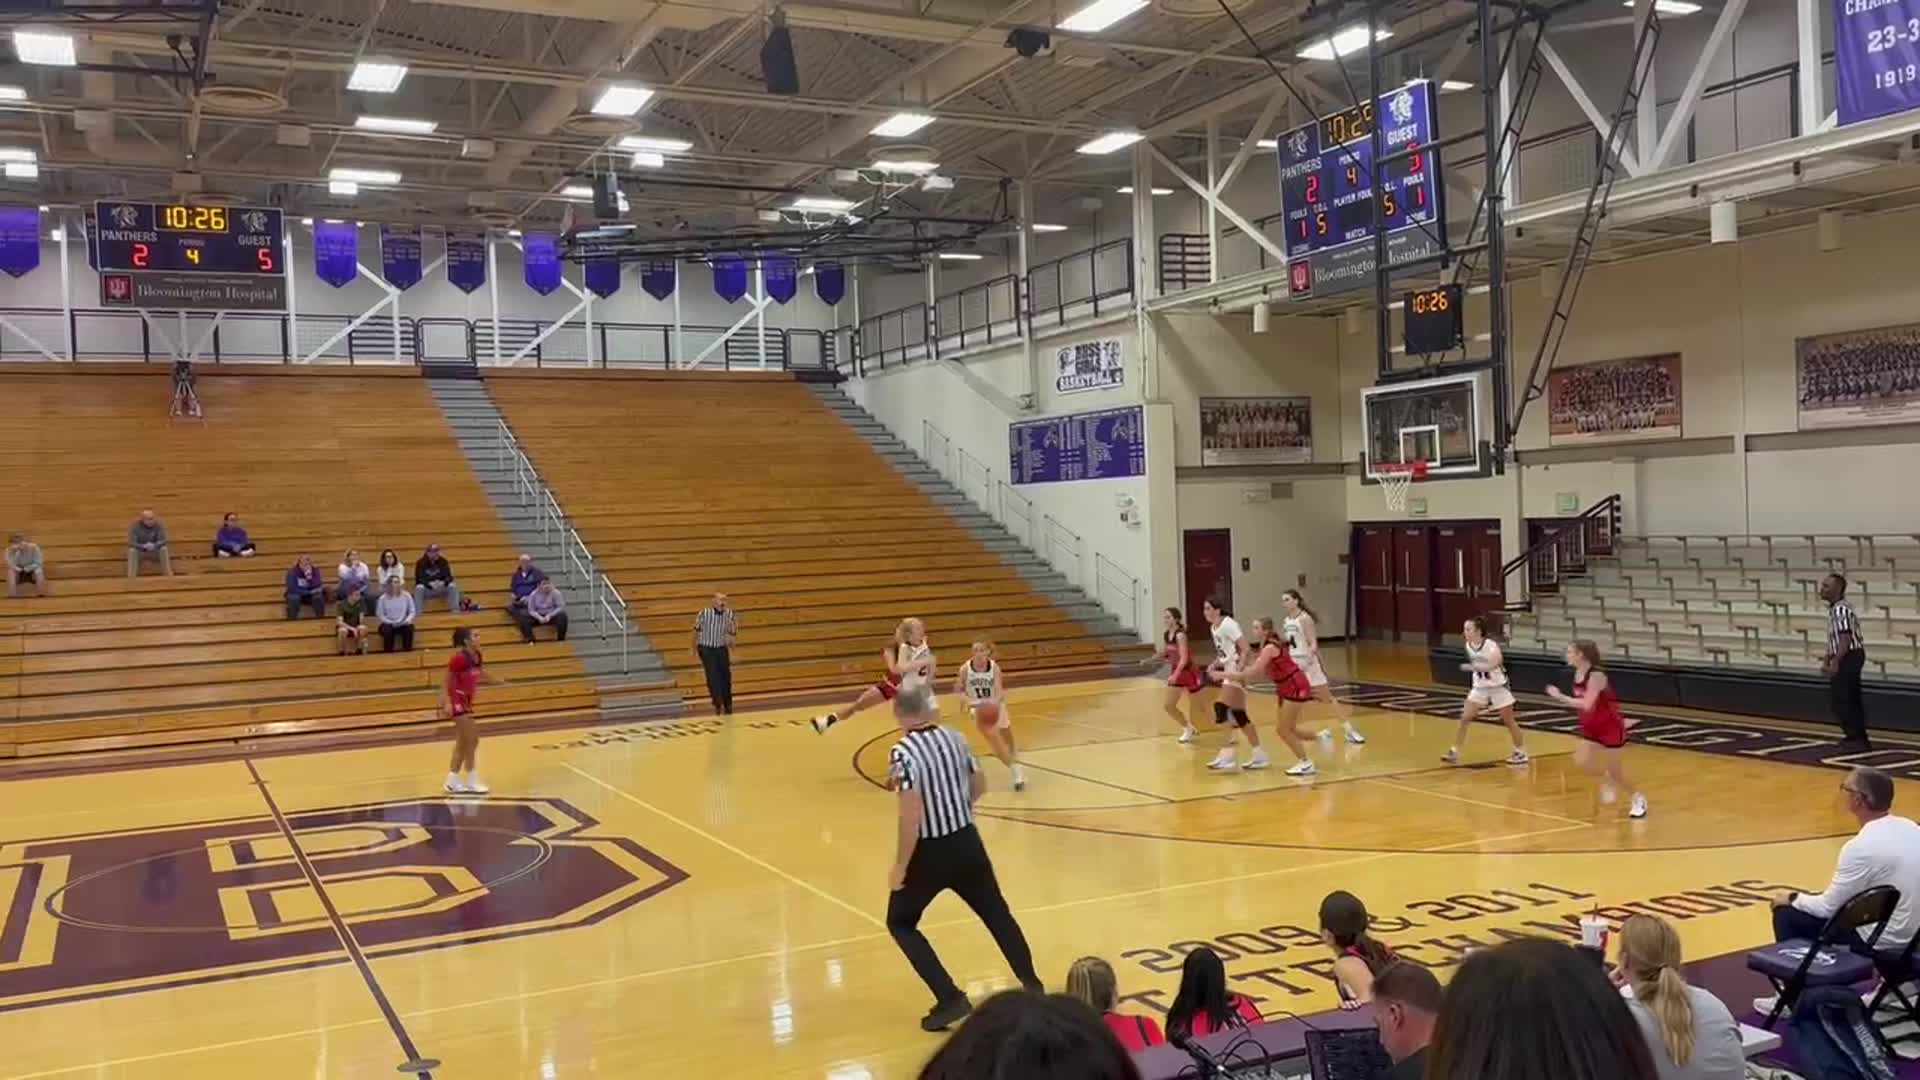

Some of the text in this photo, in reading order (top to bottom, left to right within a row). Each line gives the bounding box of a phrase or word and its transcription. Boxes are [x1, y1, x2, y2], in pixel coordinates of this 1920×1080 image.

[1867, 18, 1919, 53] 23-3
[1875, 64, 1916, 89] 1919
[1387, 124, 1418, 145] GUEST
[1282, 157, 1322, 179] PANTHERS
[1347, 167, 1356, 185] 4
[1306, 175, 1317, 202] 2
[1384, 194, 1394, 215] 5
[165, 207, 224, 229] 10:26
[1317, 213, 1326, 234] 5
[101, 230, 158, 242] PANTHERS
[237, 235, 271, 246] GUEST
[133, 244, 148, 266] 2
[186, 249, 199, 264] 4
[258, 248, 272, 270] 5
[138, 284, 278, 304] Bloomington Hospital
[1412, 291, 1448, 313] 10:26
[1122, 924, 1326, 974] 2009
[1404, 882, 1598, 922] 2011
